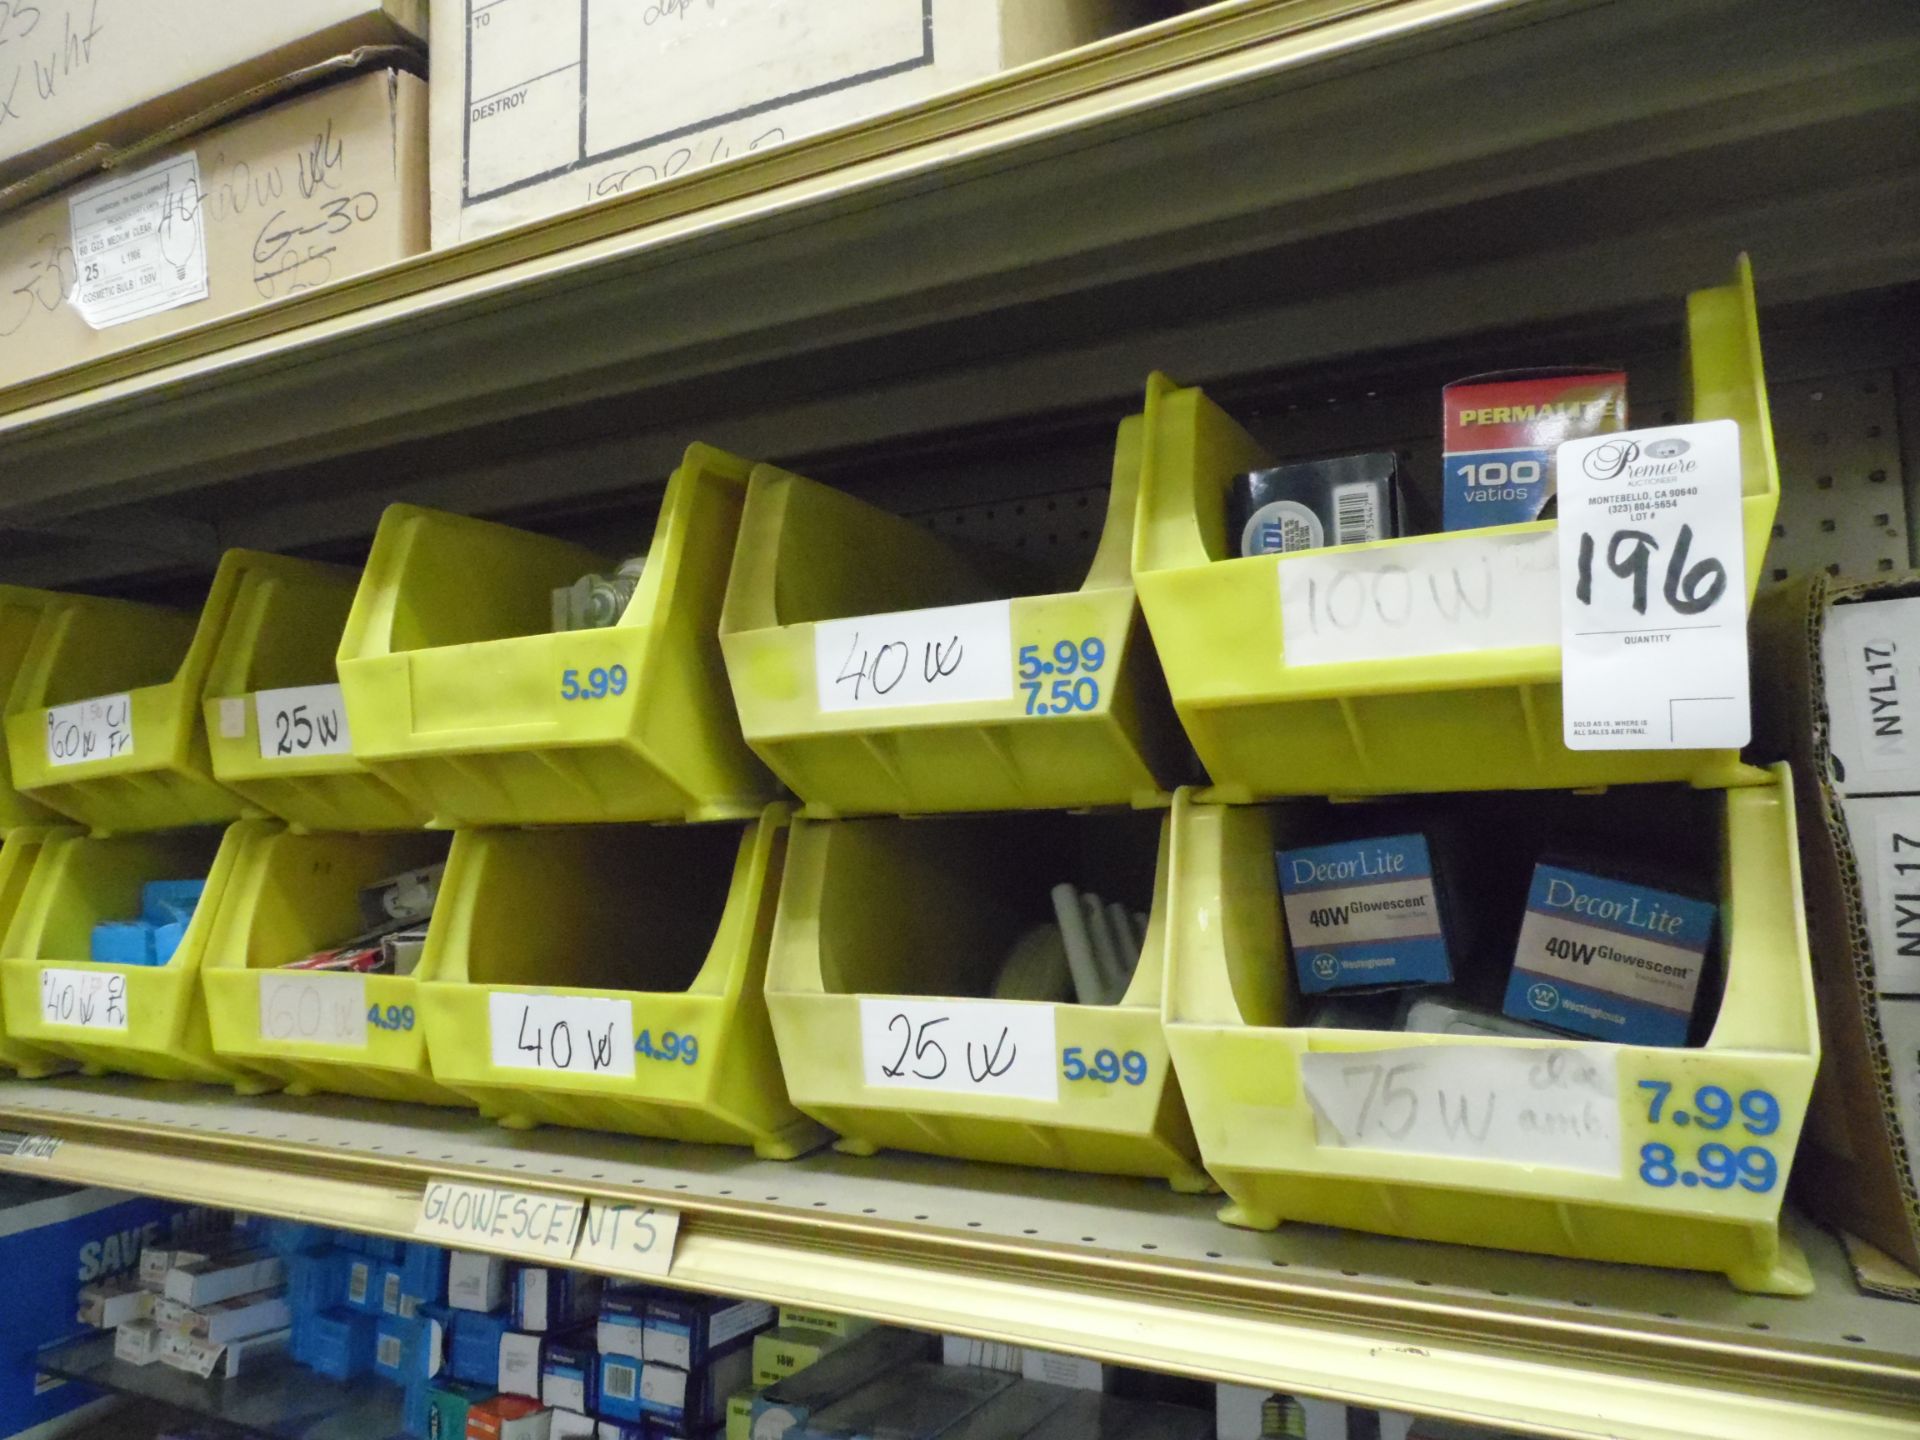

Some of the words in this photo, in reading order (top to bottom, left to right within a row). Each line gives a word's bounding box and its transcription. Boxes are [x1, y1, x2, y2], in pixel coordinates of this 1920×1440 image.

[474, 12, 490, 29] TO
[472, 89, 528, 122] DESTROY
[85, 263, 99, 282] 25
[82, 285, 114, 304] COSMETIC
[1457, 461, 1540, 487] 100
[1583, 439, 1698, 480] Premiere
[1464, 487, 1528, 502] vatios
[1588, 492, 1652, 505] MONTEBELLO,
[1655, 490, 1667, 498] CA
[1669, 487, 1698, 500] 90640
[1608, 502, 1632, 514] (323)
[1630, 513, 1648, 521] LOT
[1576, 523, 1728, 616] 196
[1624, 634, 1672, 645] QUANTITY
[1019, 638, 1105, 679] 5.99
[561, 664, 628, 700] 5.99
[1020, 677, 1099, 715] 7.50
[1864, 641, 1903, 736] NYL17
[1292, 849, 1405, 884] DecorLite
[1309, 905, 1350, 928] 40W
[1545, 878, 1684, 935] DecorLite
[1545, 937, 1597, 966] 40W
[367, 1003, 415, 1031] 4.99
[634, 1029, 699, 1066] 4.99
[1063, 1047, 1148, 1085] 5.99
[1638, 1080, 1780, 1137] 7.99
[1639, 1143, 1778, 1193] 8.99
[424, 1185, 657, 1253] GLOWESCENTS
